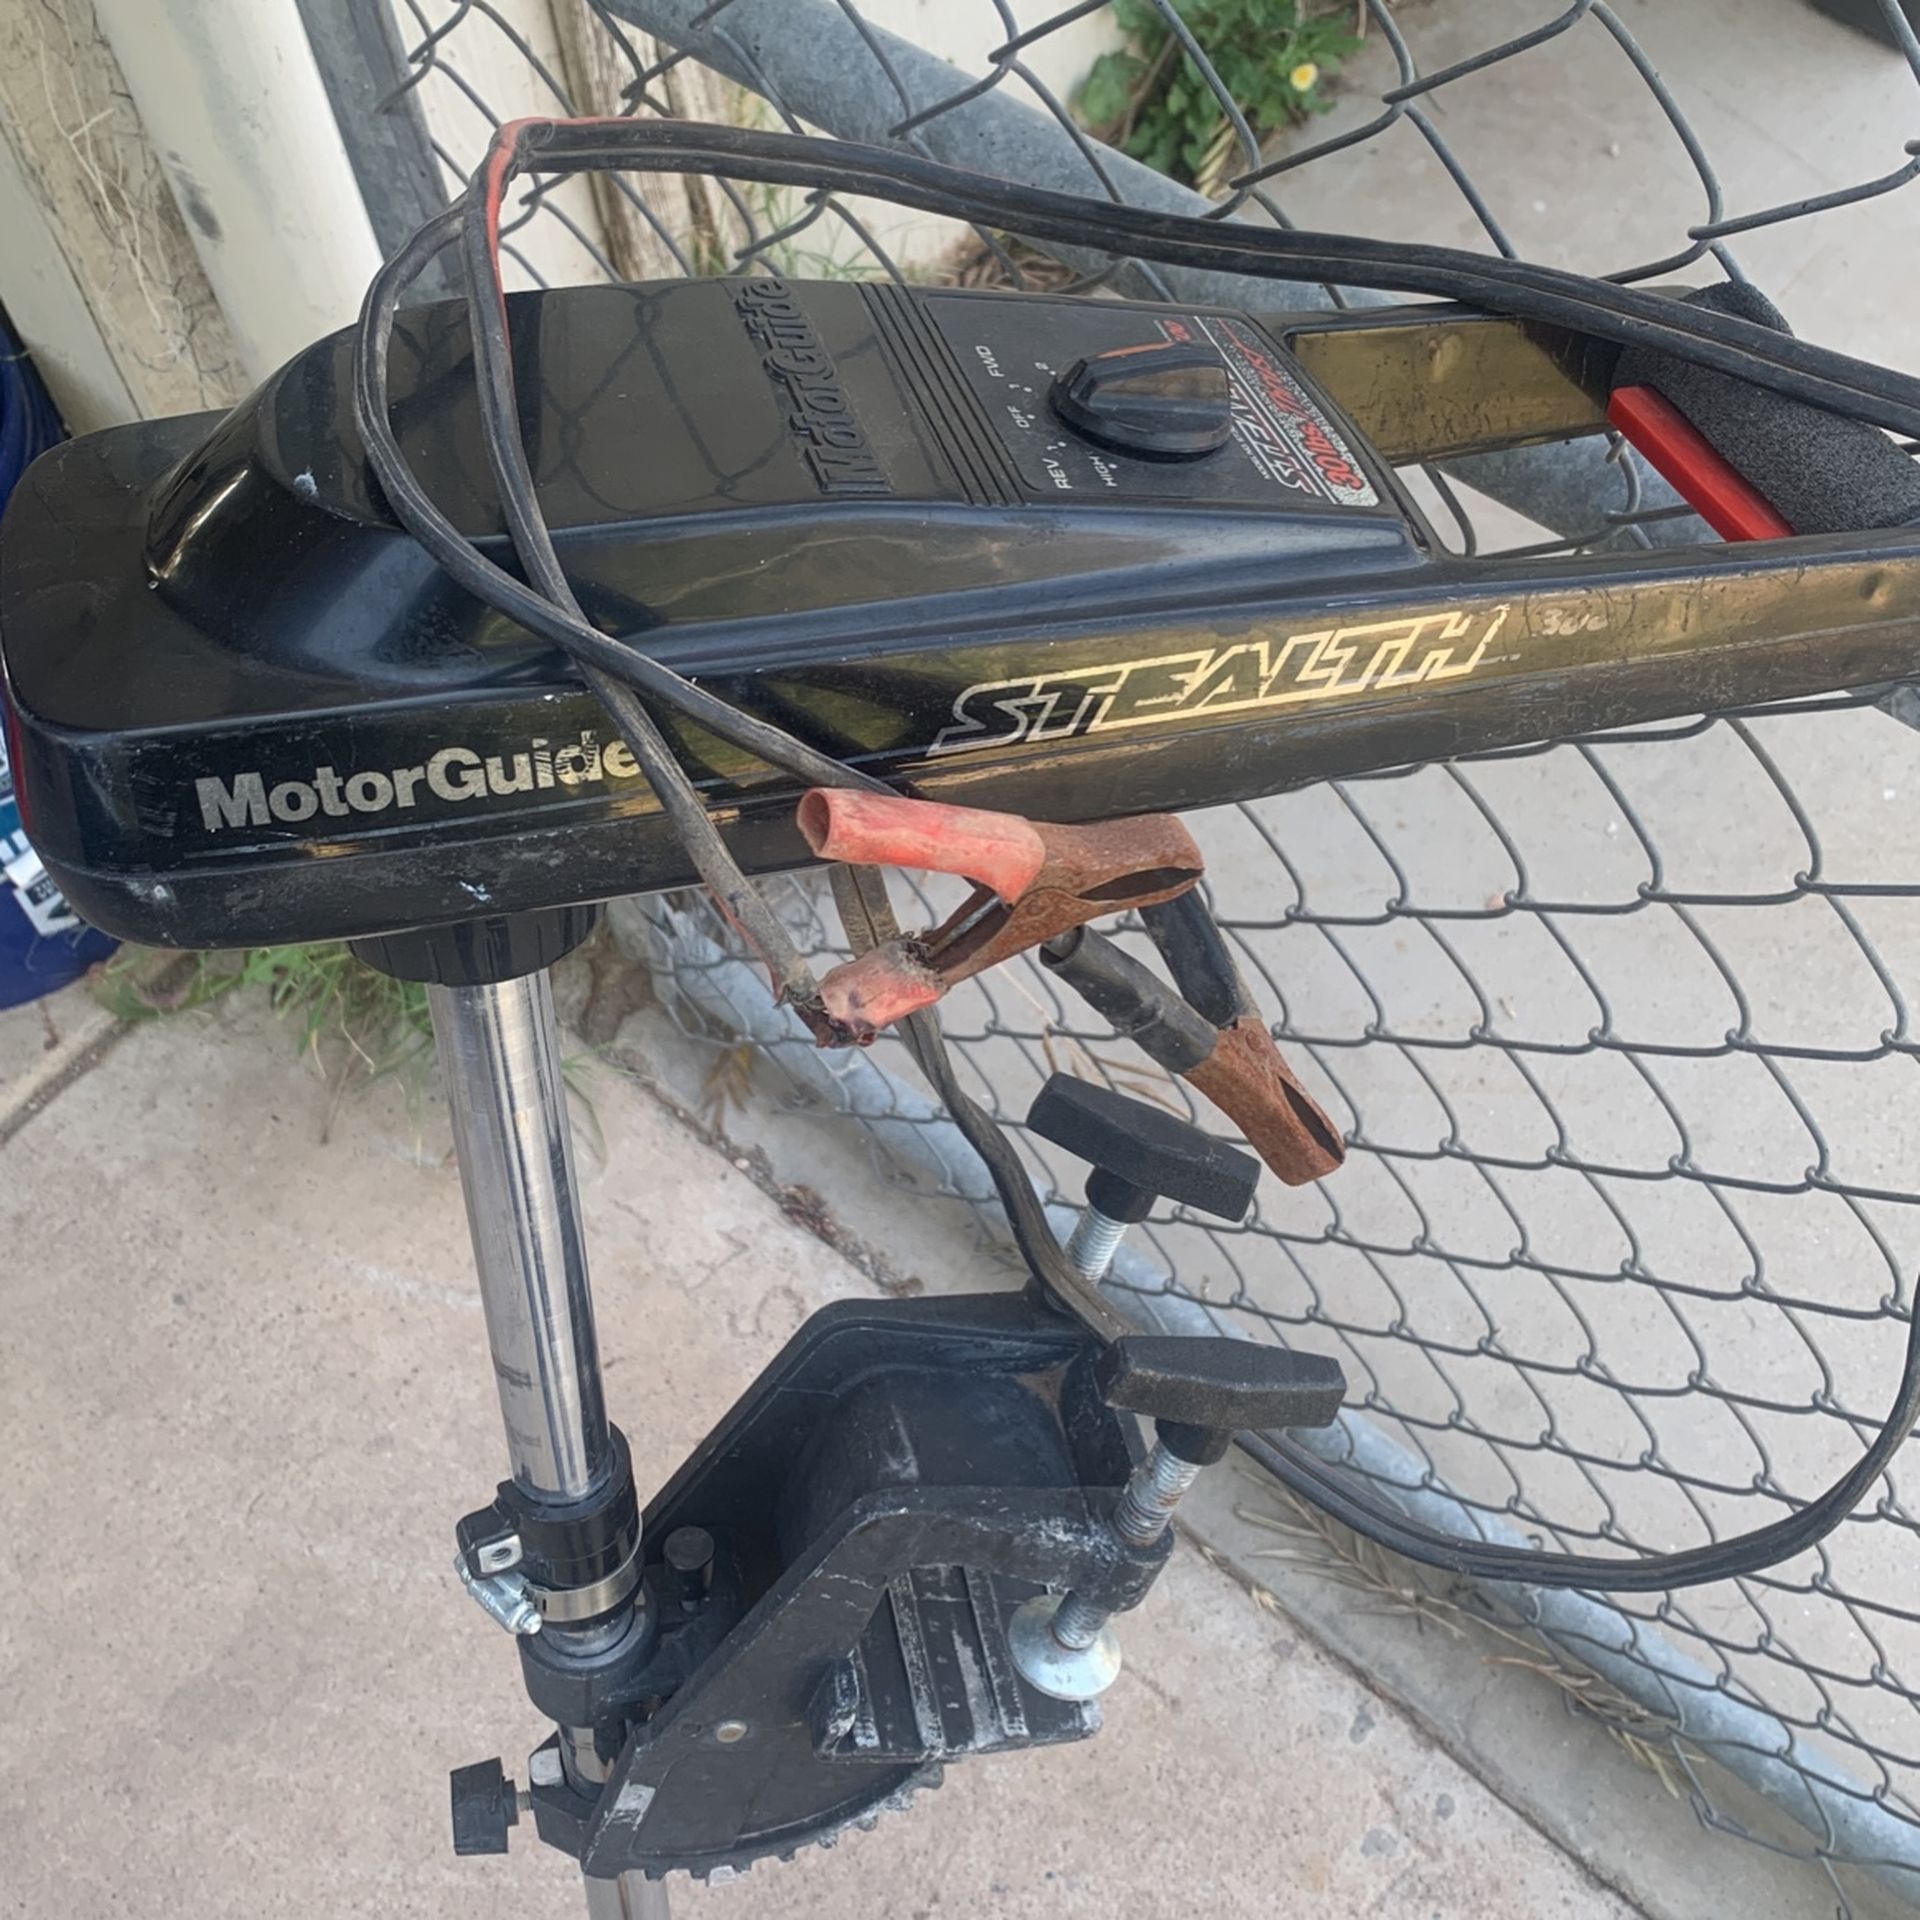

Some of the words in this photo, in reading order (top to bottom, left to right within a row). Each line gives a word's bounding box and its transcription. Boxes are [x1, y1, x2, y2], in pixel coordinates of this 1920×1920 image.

[975, 345, 1005, 377] FWD
[1006, 405, 1030, 428] OFF
[1042, 458, 1073, 489] REV
[1089, 455, 1118, 487] HIGH
[1313, 453, 1365, 490] 30
[927, 603, 1511, 757] STEALTH
[195, 730, 642, 831] MotorGuide
